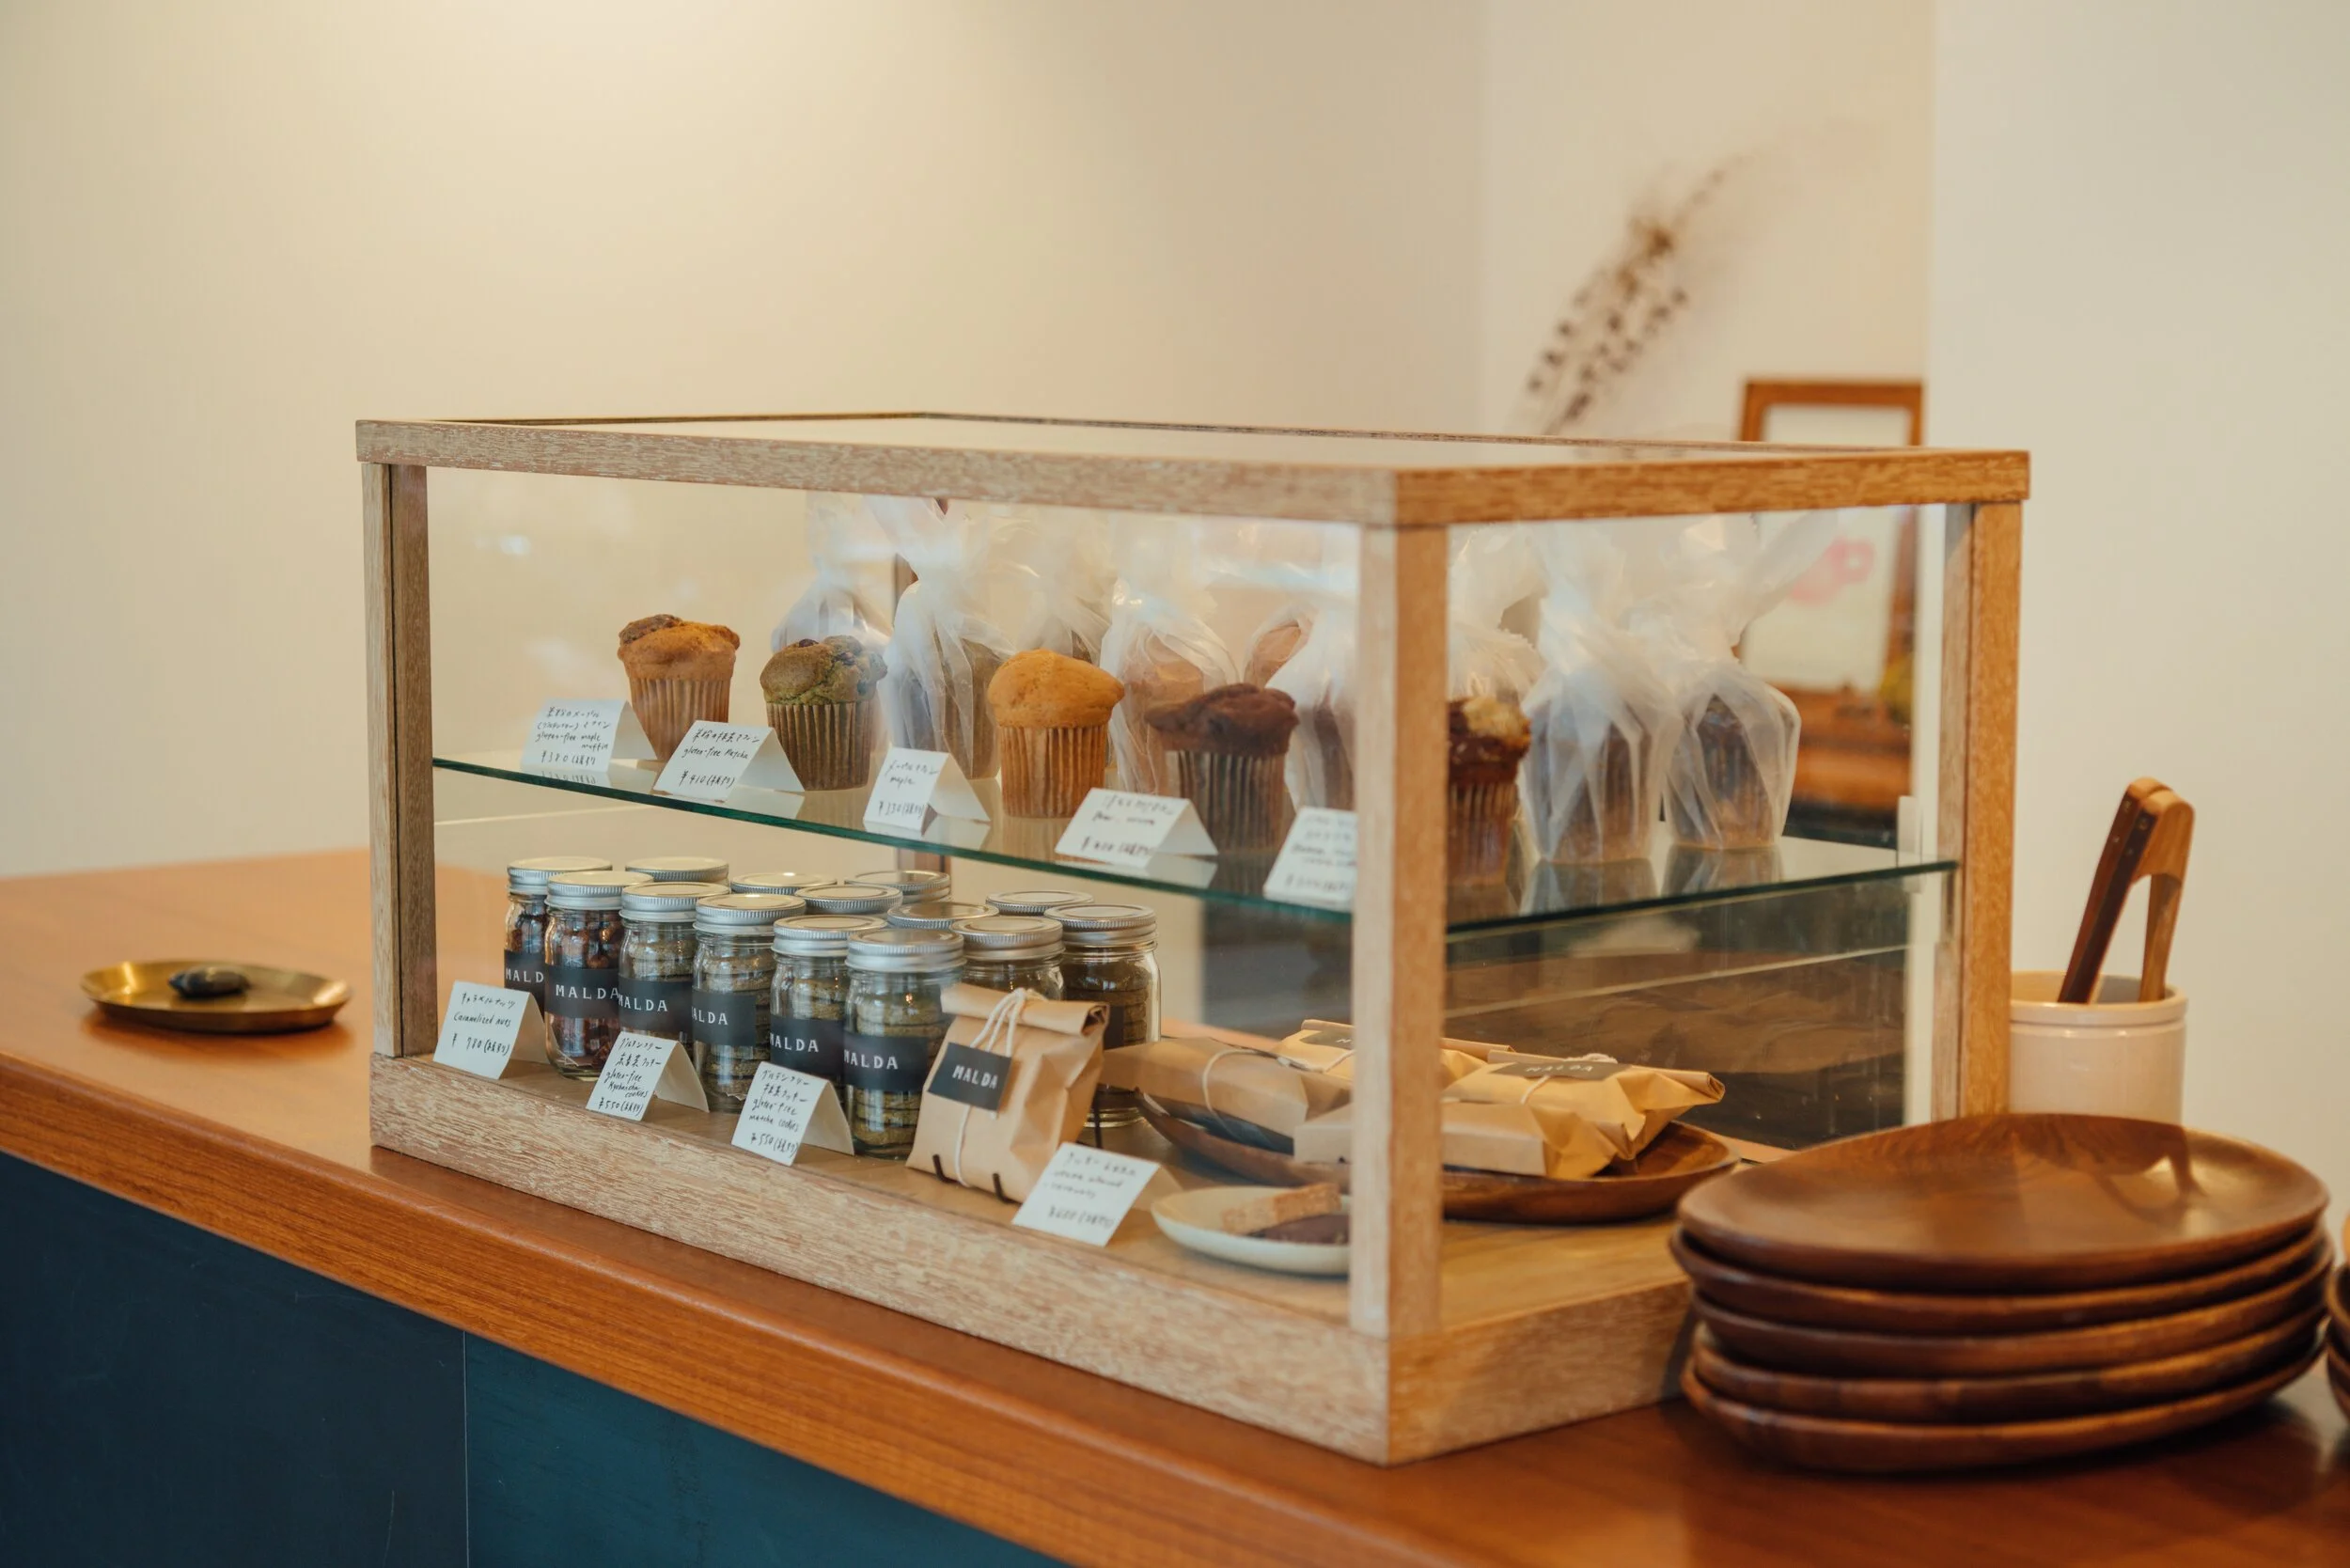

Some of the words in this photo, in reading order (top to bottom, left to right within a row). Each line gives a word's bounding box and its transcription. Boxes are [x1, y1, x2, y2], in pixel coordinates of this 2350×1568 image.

[506, 968, 544, 983] MALD
[556, 984, 619, 1000] MALDA
[952, 1064, 998, 1090] MALDA
